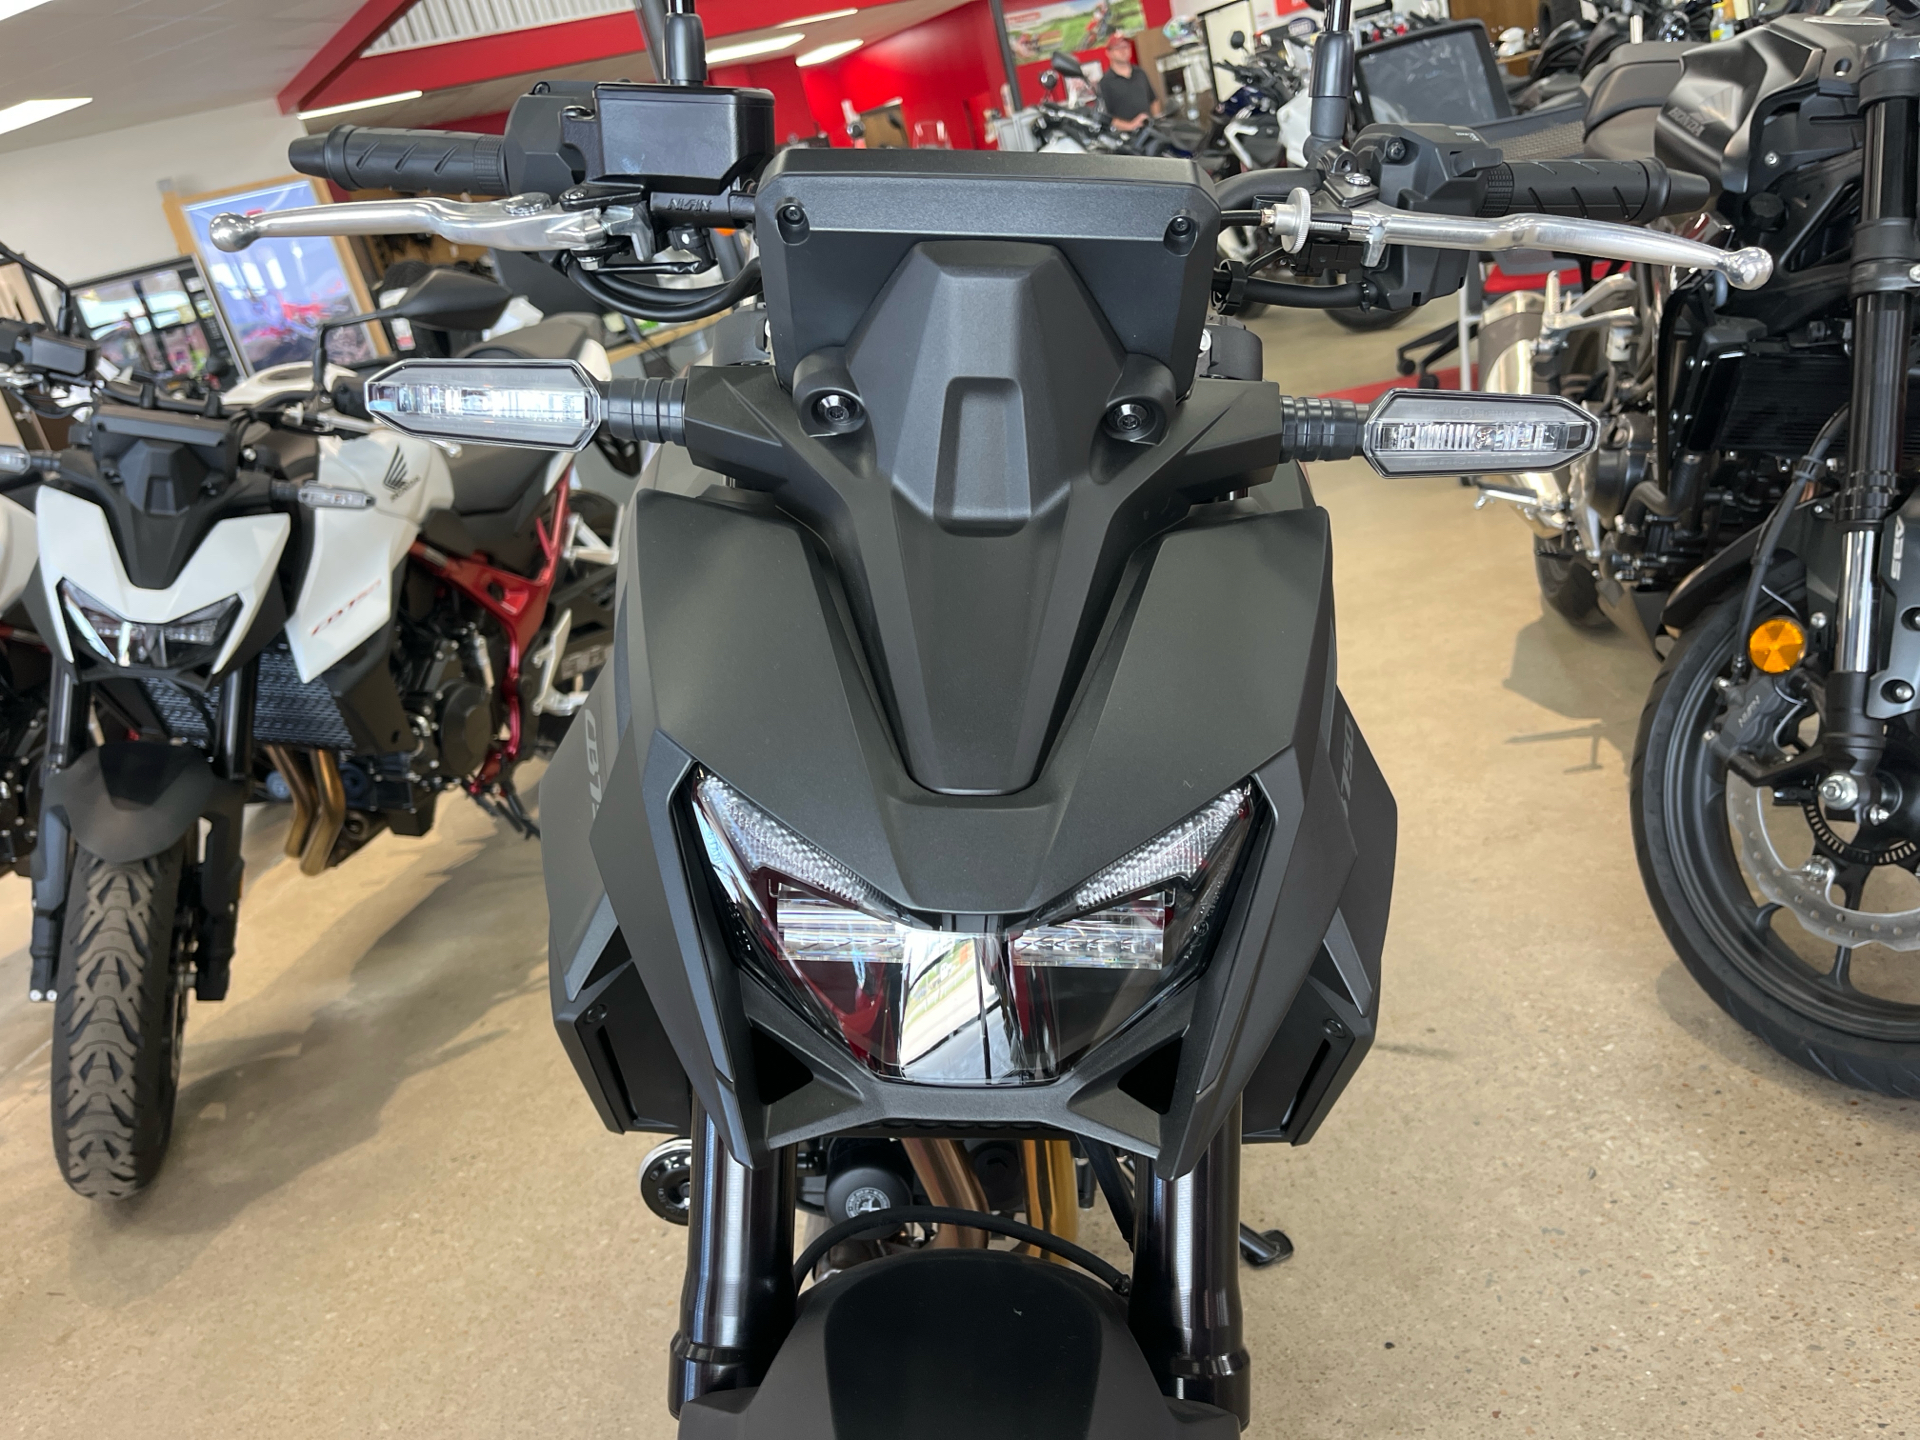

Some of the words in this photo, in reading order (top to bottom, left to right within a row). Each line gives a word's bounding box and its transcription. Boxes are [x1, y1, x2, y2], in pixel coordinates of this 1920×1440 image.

[1668, 106, 1705, 137] HONDA
[1891, 515, 1905, 581] ABS
[1340, 713, 1354, 819] 750
